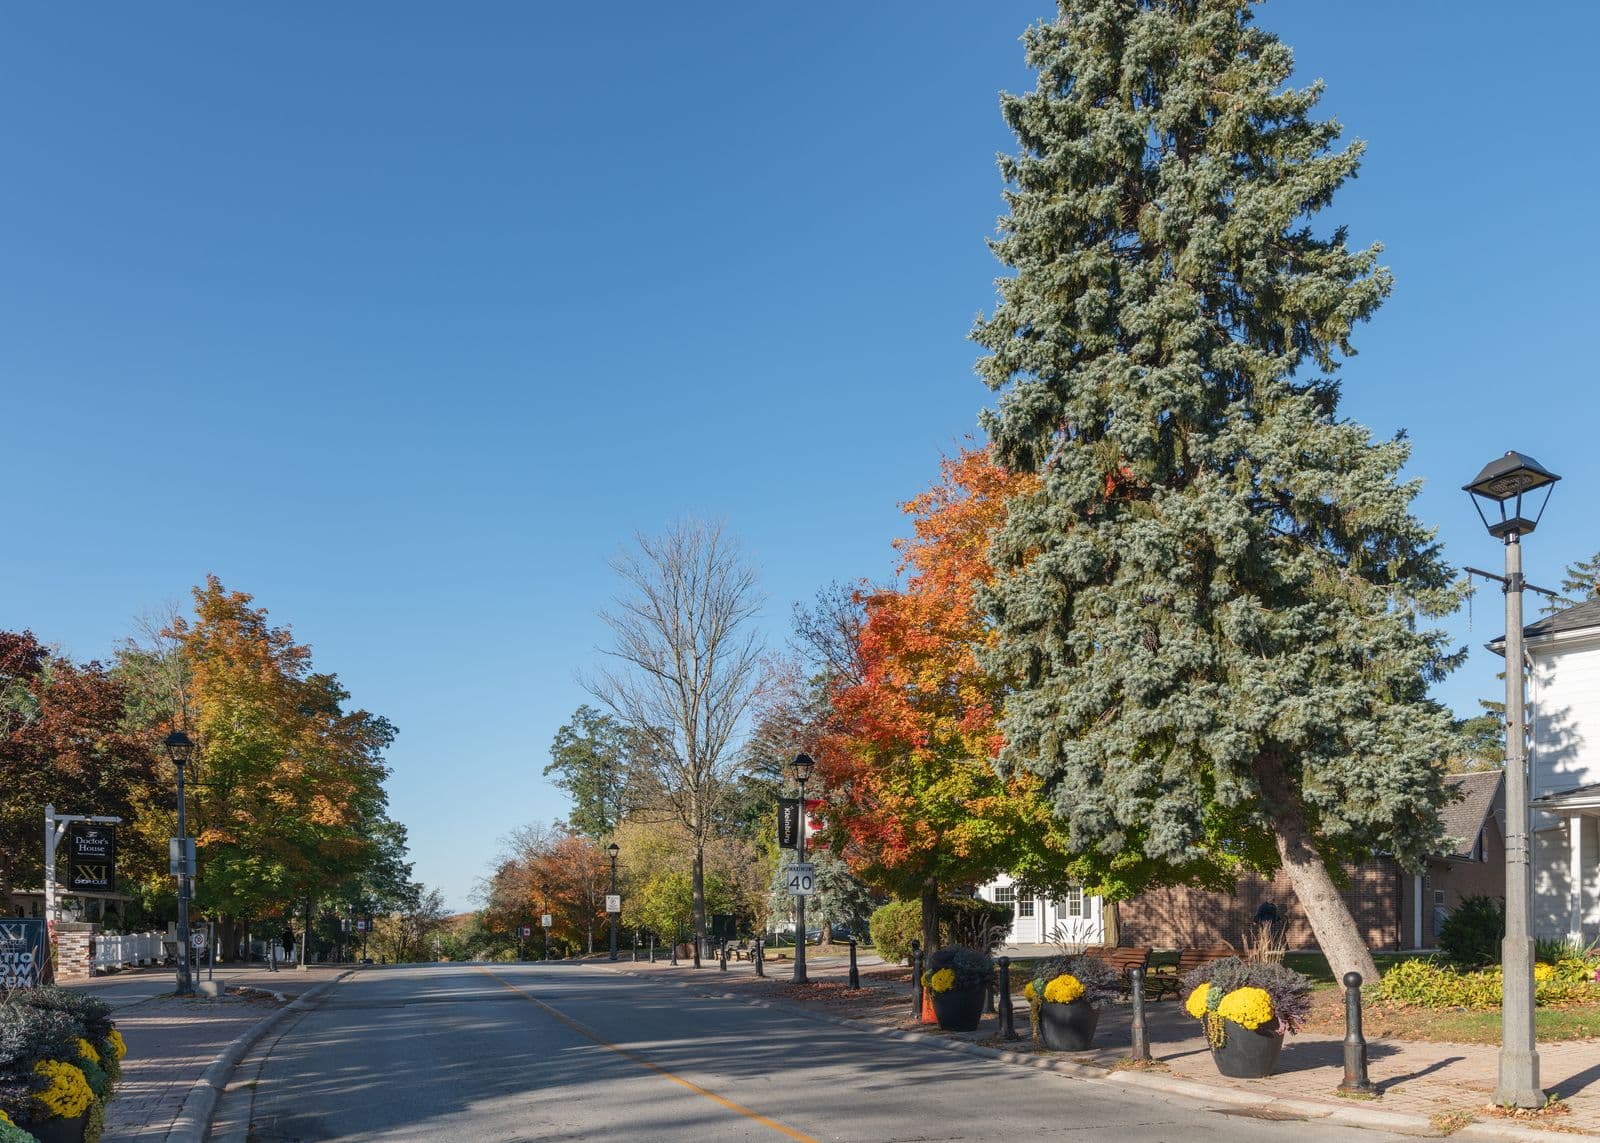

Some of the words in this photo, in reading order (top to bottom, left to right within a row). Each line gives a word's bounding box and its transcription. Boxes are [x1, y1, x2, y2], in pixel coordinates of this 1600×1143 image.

[75, 836, 109, 844] Doctor's
[789, 875, 812, 890] 40
[0, 952, 33, 963] TIO
